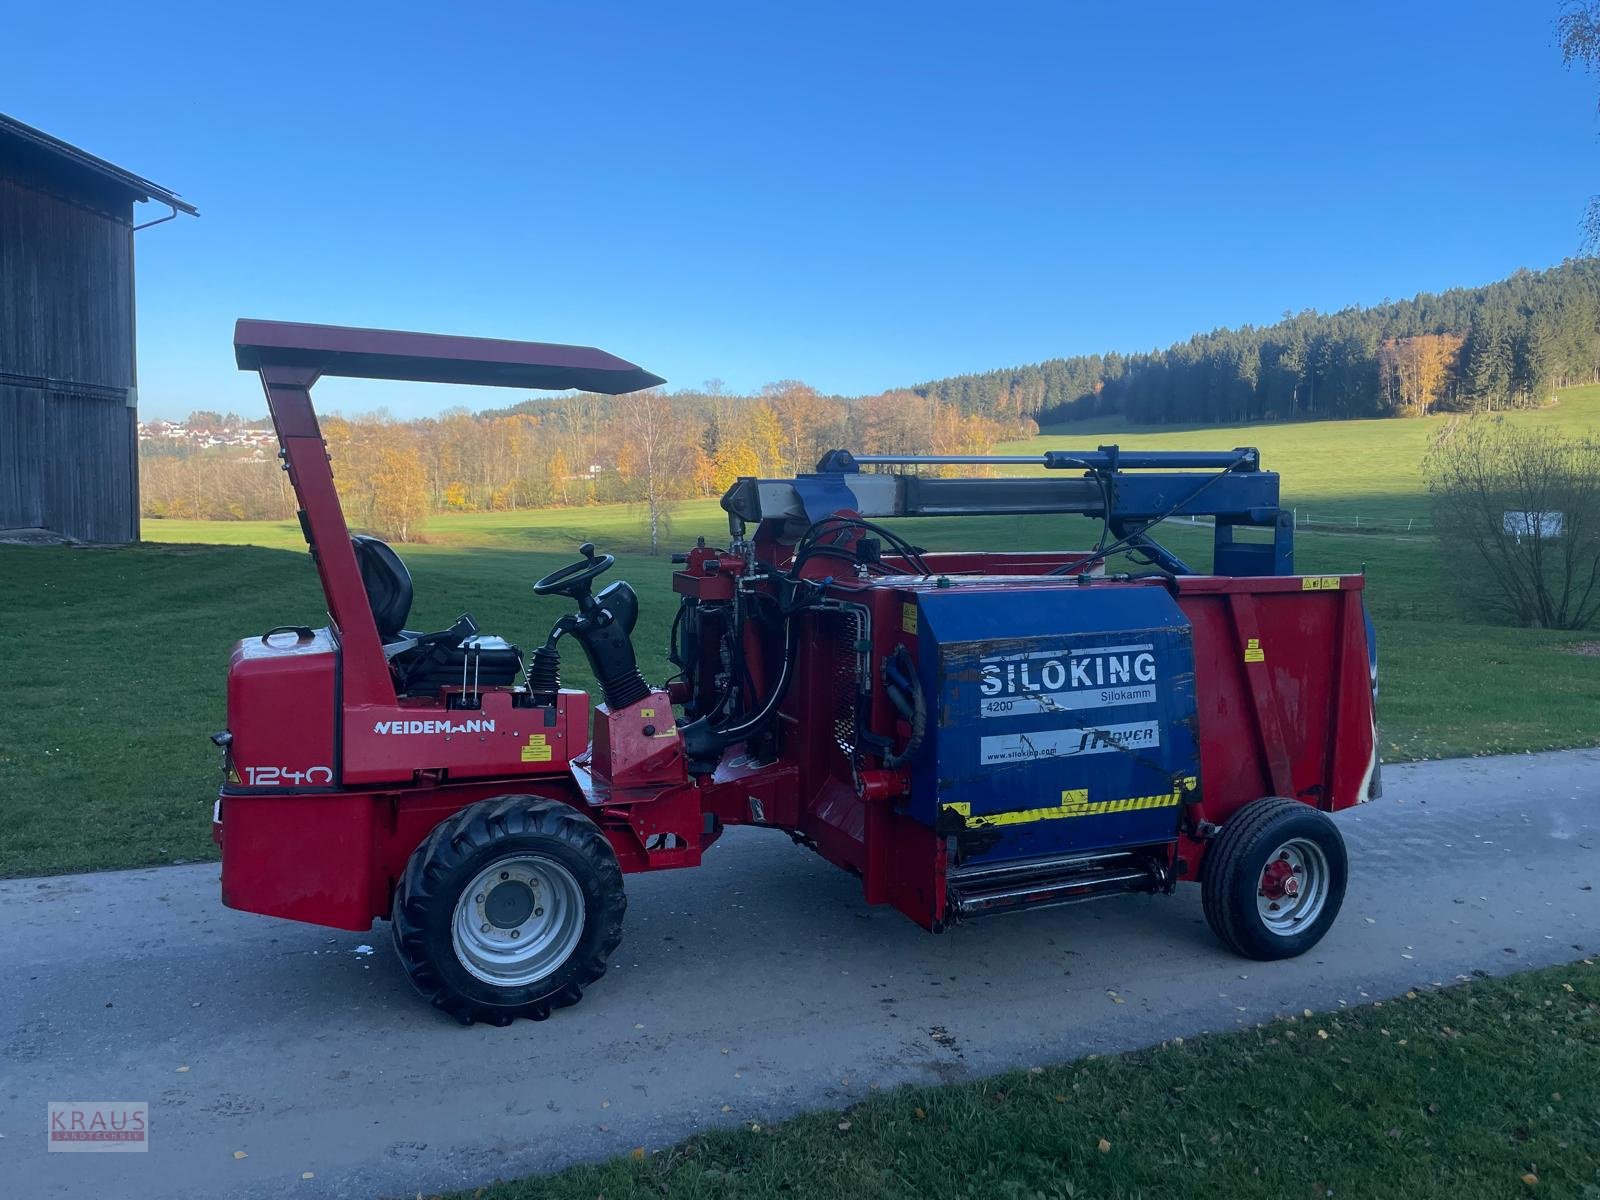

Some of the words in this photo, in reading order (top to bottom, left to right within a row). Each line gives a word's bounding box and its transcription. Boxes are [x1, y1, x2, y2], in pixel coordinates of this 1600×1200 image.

[980, 653, 1156, 695] SILOKING
[1101, 689, 1151, 702] Silokamm
[986, 701, 1013, 712] 4200
[245, 766, 333, 785] 1240
